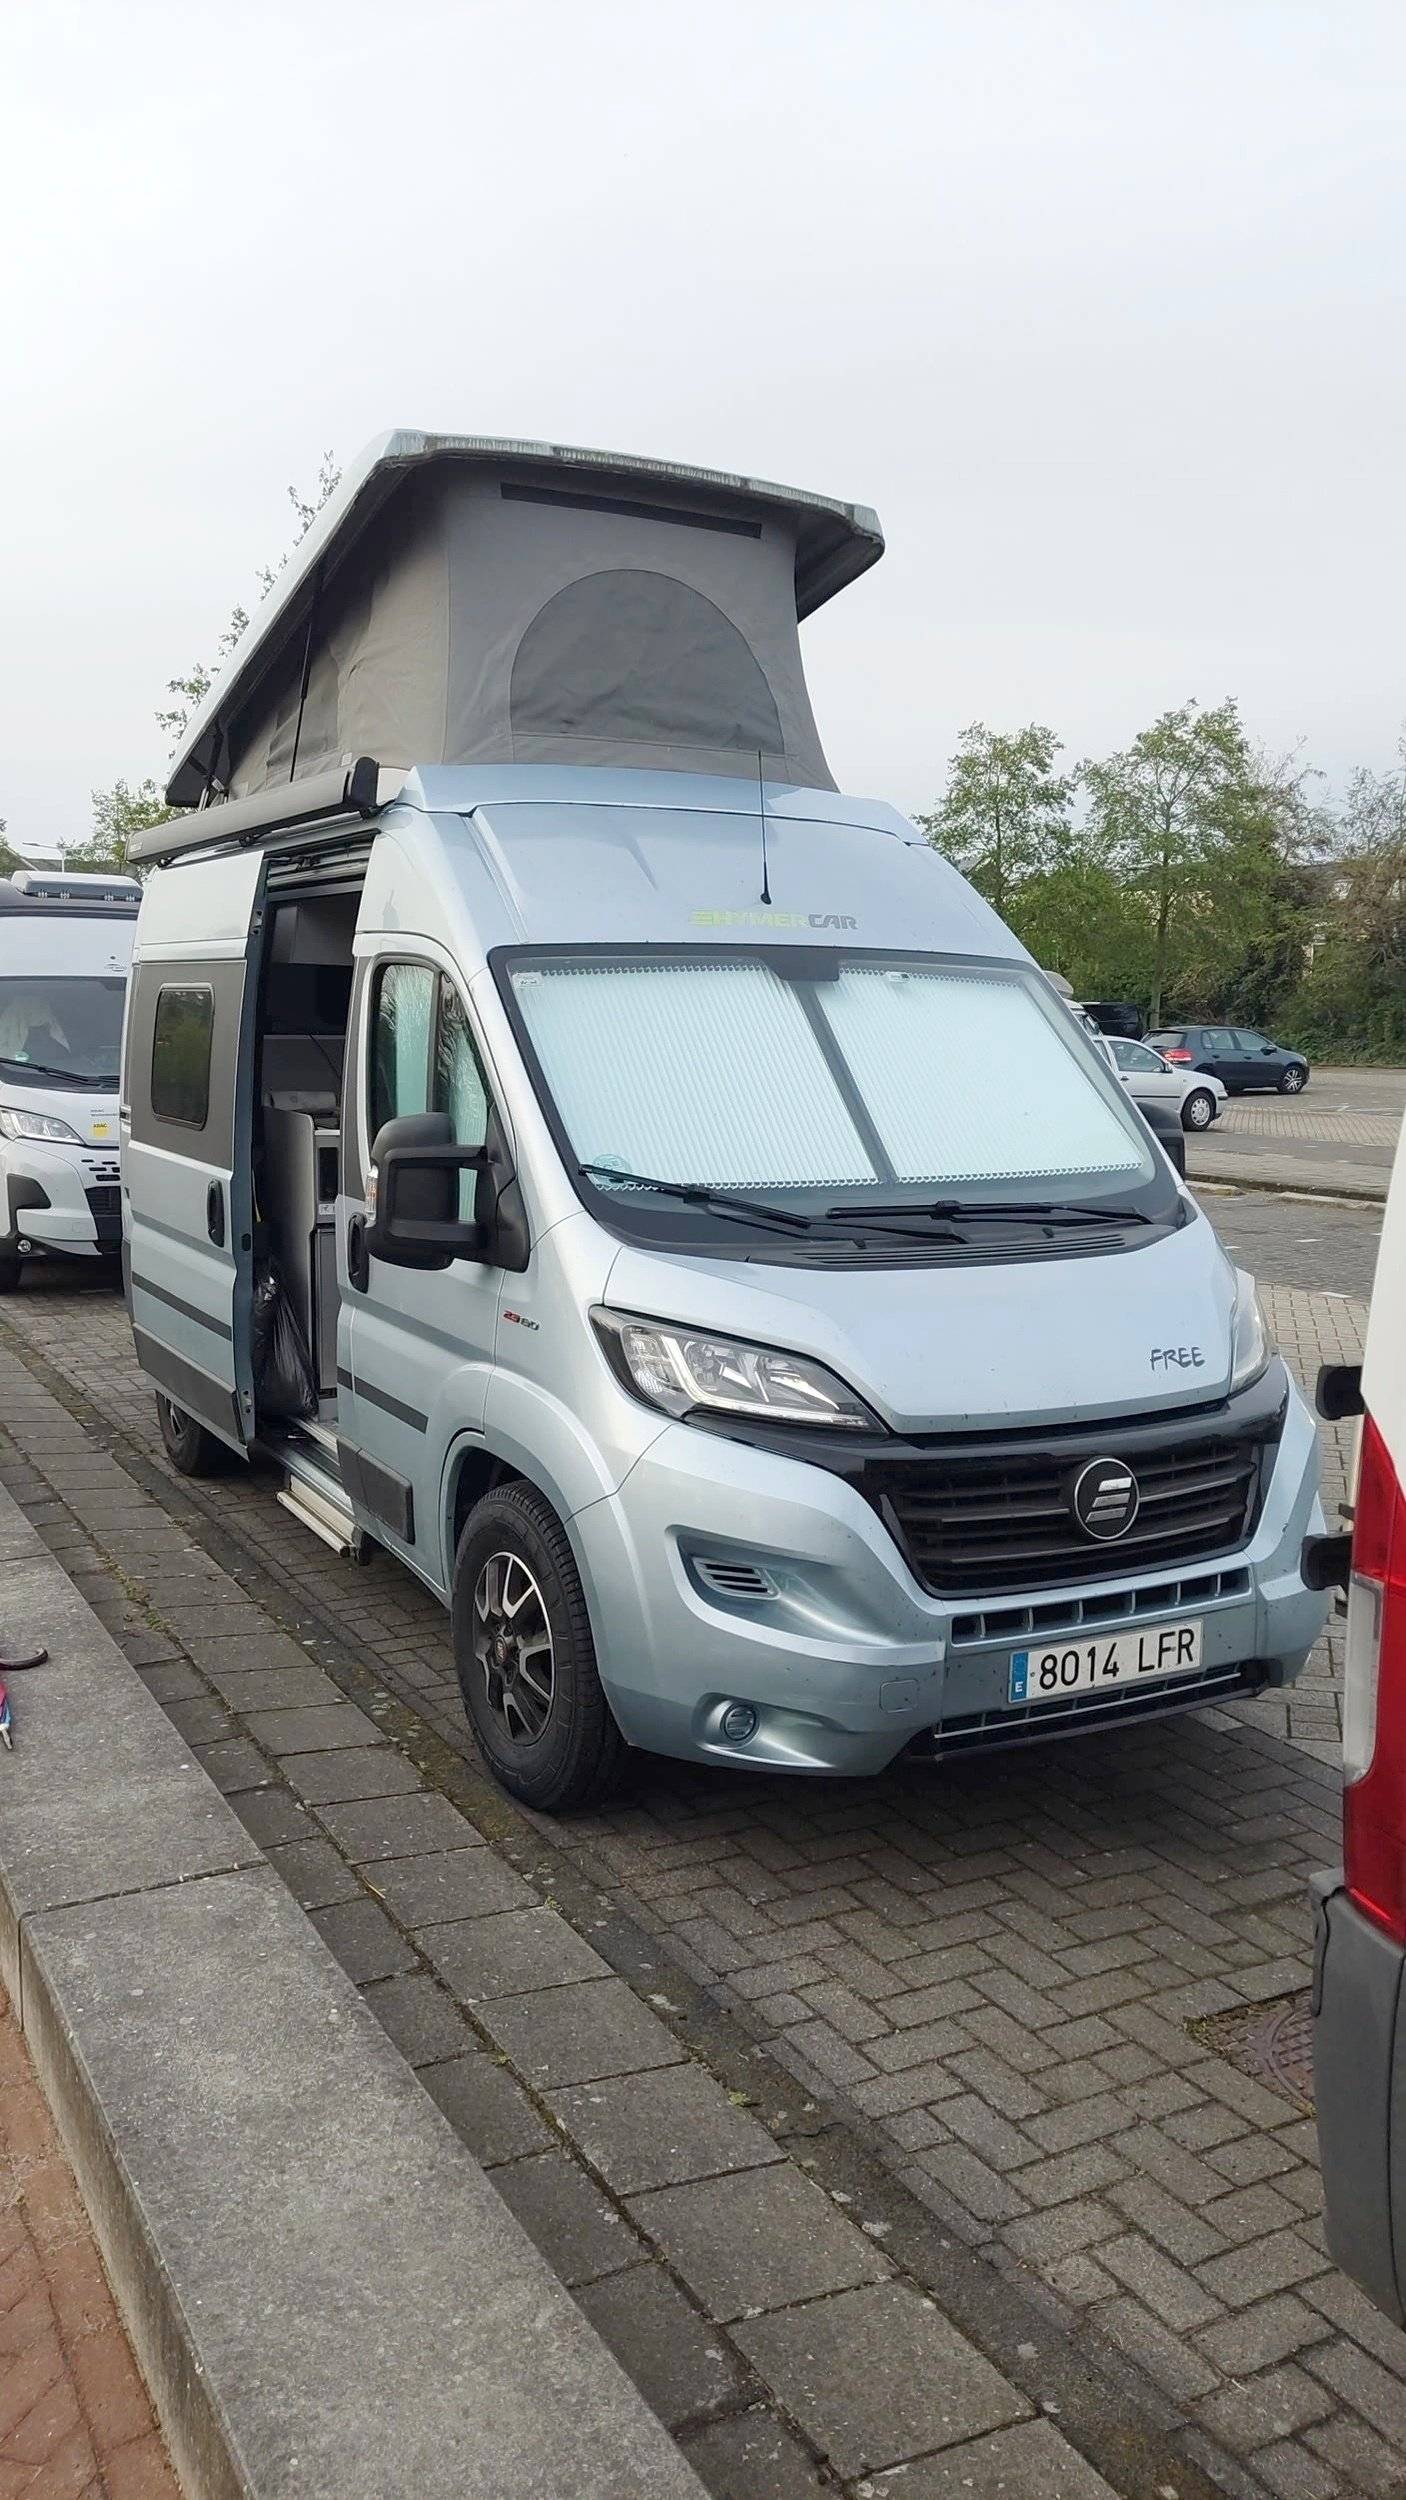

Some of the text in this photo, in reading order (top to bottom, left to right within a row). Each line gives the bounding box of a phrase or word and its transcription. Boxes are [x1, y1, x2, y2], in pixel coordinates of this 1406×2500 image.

[1150, 1346, 1206, 1371] FREE
[1015, 1628, 1195, 1692] E 8014 LFR
